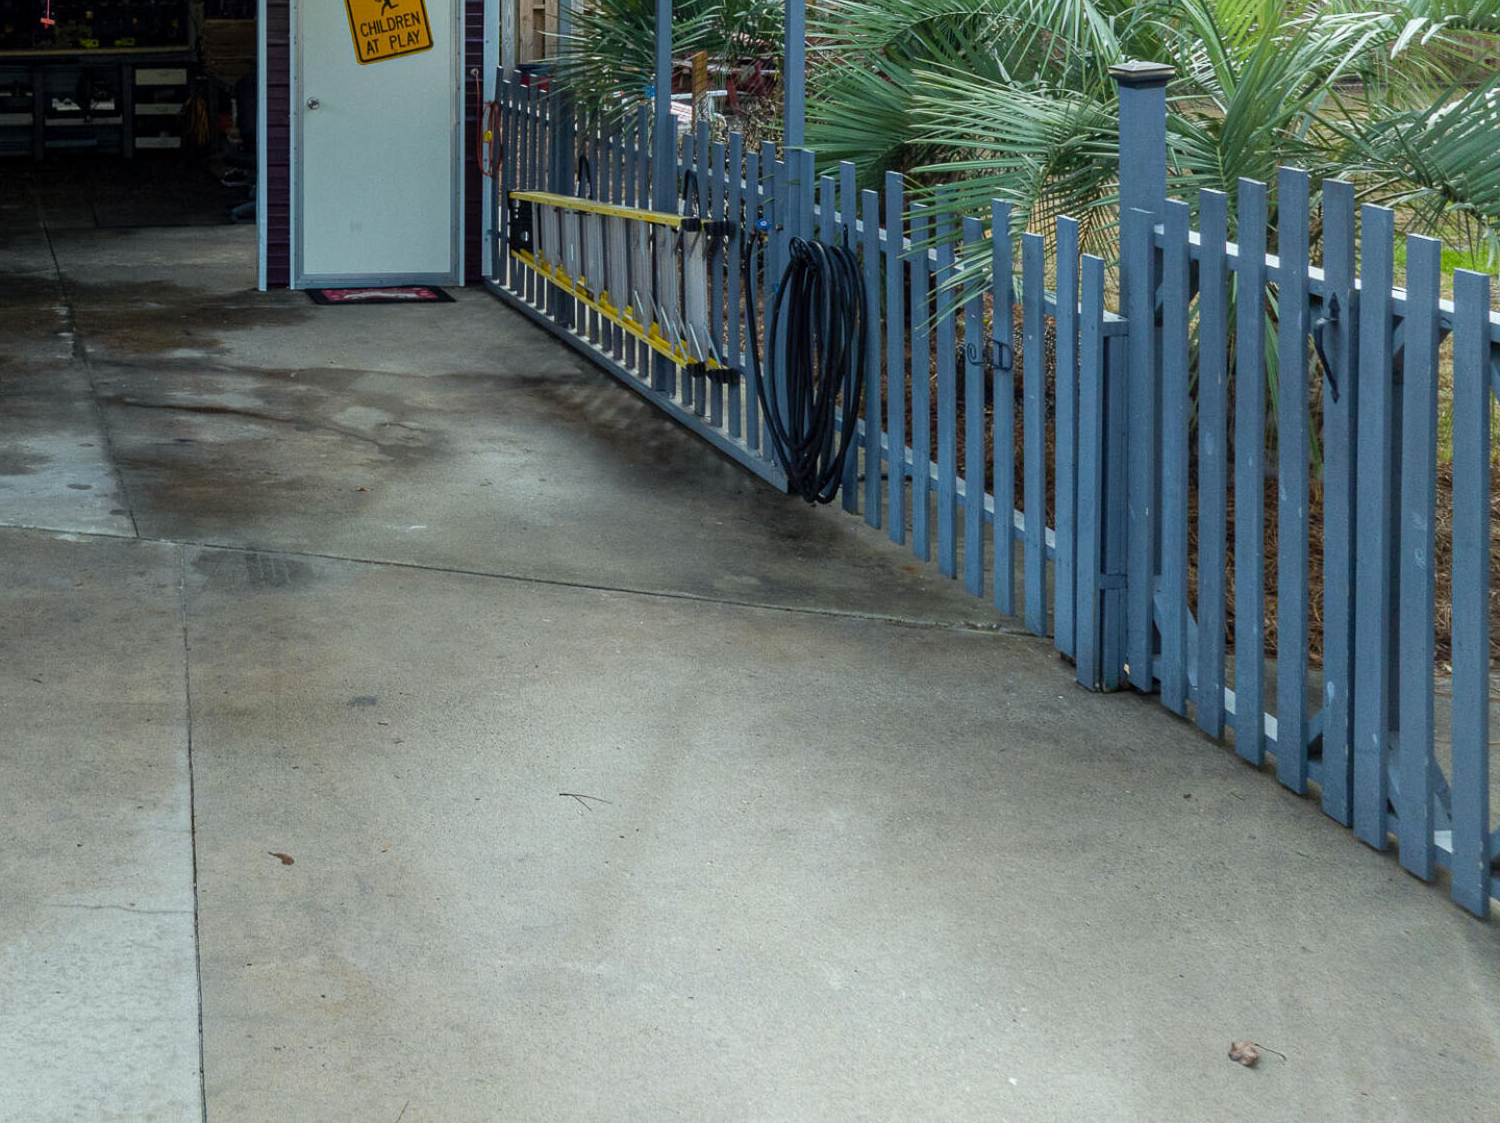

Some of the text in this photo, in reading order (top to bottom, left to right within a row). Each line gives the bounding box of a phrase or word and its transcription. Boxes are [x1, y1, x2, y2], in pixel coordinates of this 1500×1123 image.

[360, 12, 421, 37] CHILDREN
[366, 30, 420, 55] AT PLAY
